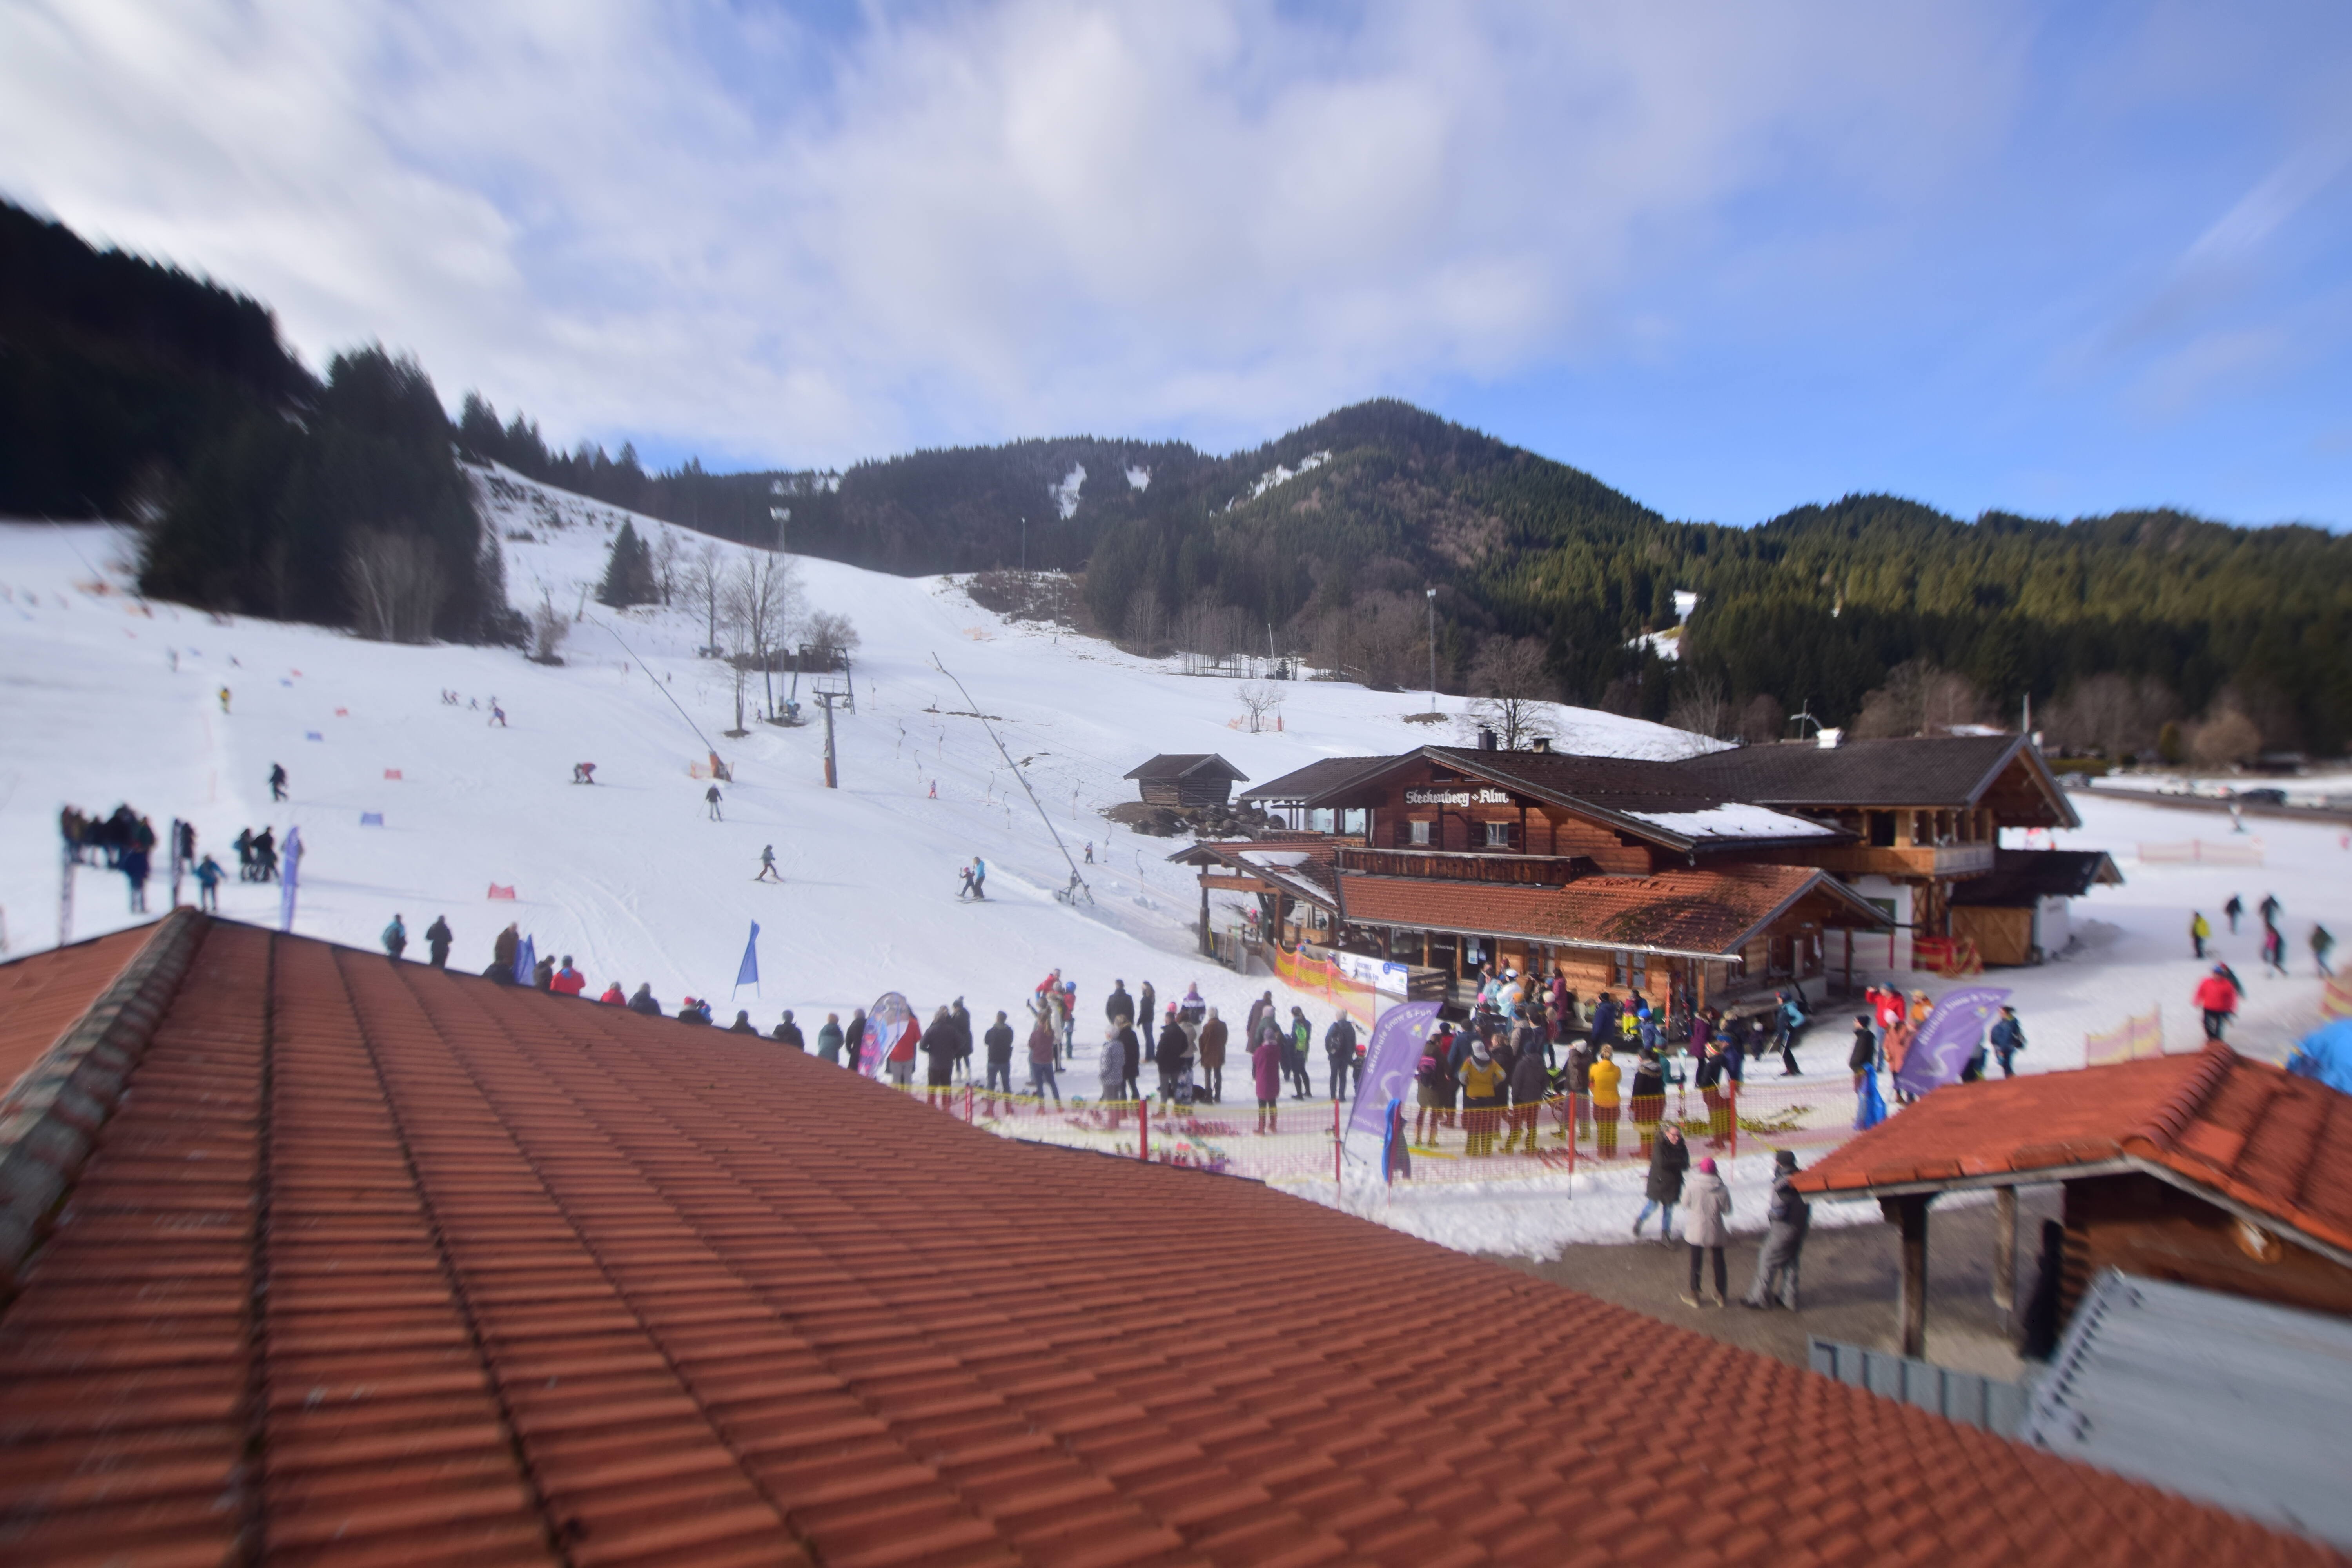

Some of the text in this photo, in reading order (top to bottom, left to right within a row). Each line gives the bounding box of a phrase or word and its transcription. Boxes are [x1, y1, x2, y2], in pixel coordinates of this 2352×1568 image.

[1406, 788, 1509, 807] Steckenberg Alm
[1368, 1031, 1388, 1074] Skischule
[1384, 1014, 1405, 1031] Snow
[1406, 1010, 1413, 1019] &
